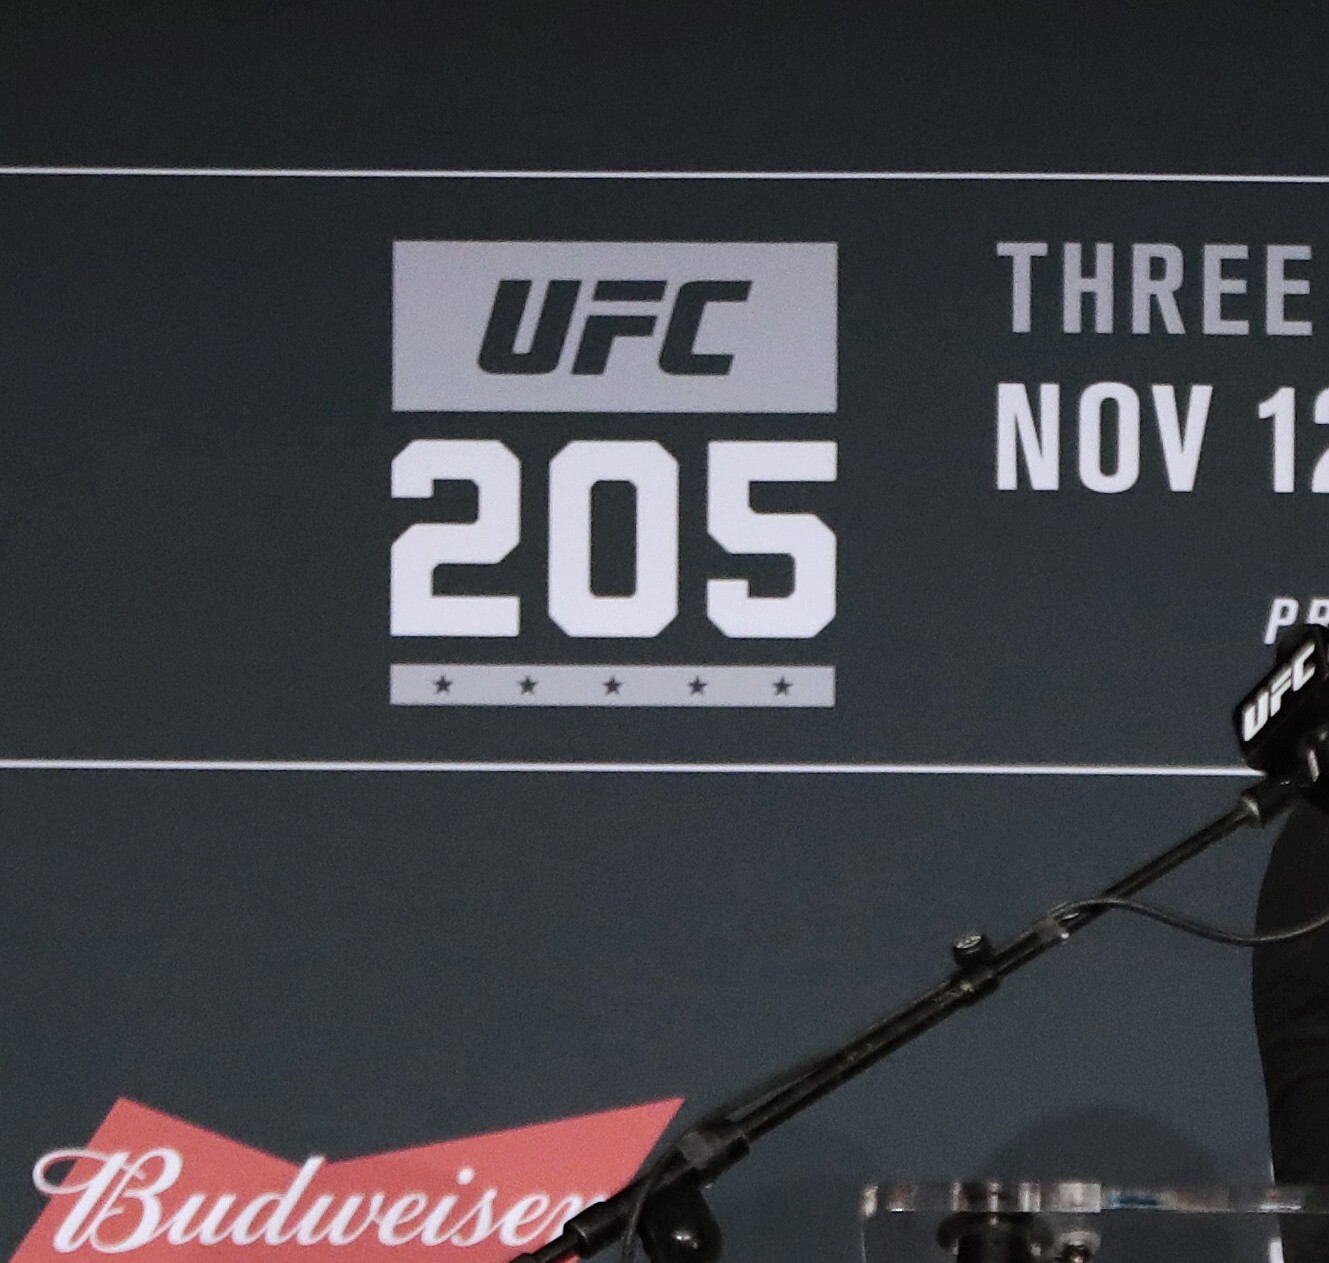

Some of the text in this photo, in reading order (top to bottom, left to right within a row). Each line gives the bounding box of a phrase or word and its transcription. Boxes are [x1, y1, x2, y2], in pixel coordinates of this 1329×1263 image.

[477, 279, 752, 376] UFC
[997, 242, 1313, 336] THREE
[997, 381, 1213, 493] NOV
[390, 439, 837, 638] 205
[1242, 639, 1316, 739] UFC
